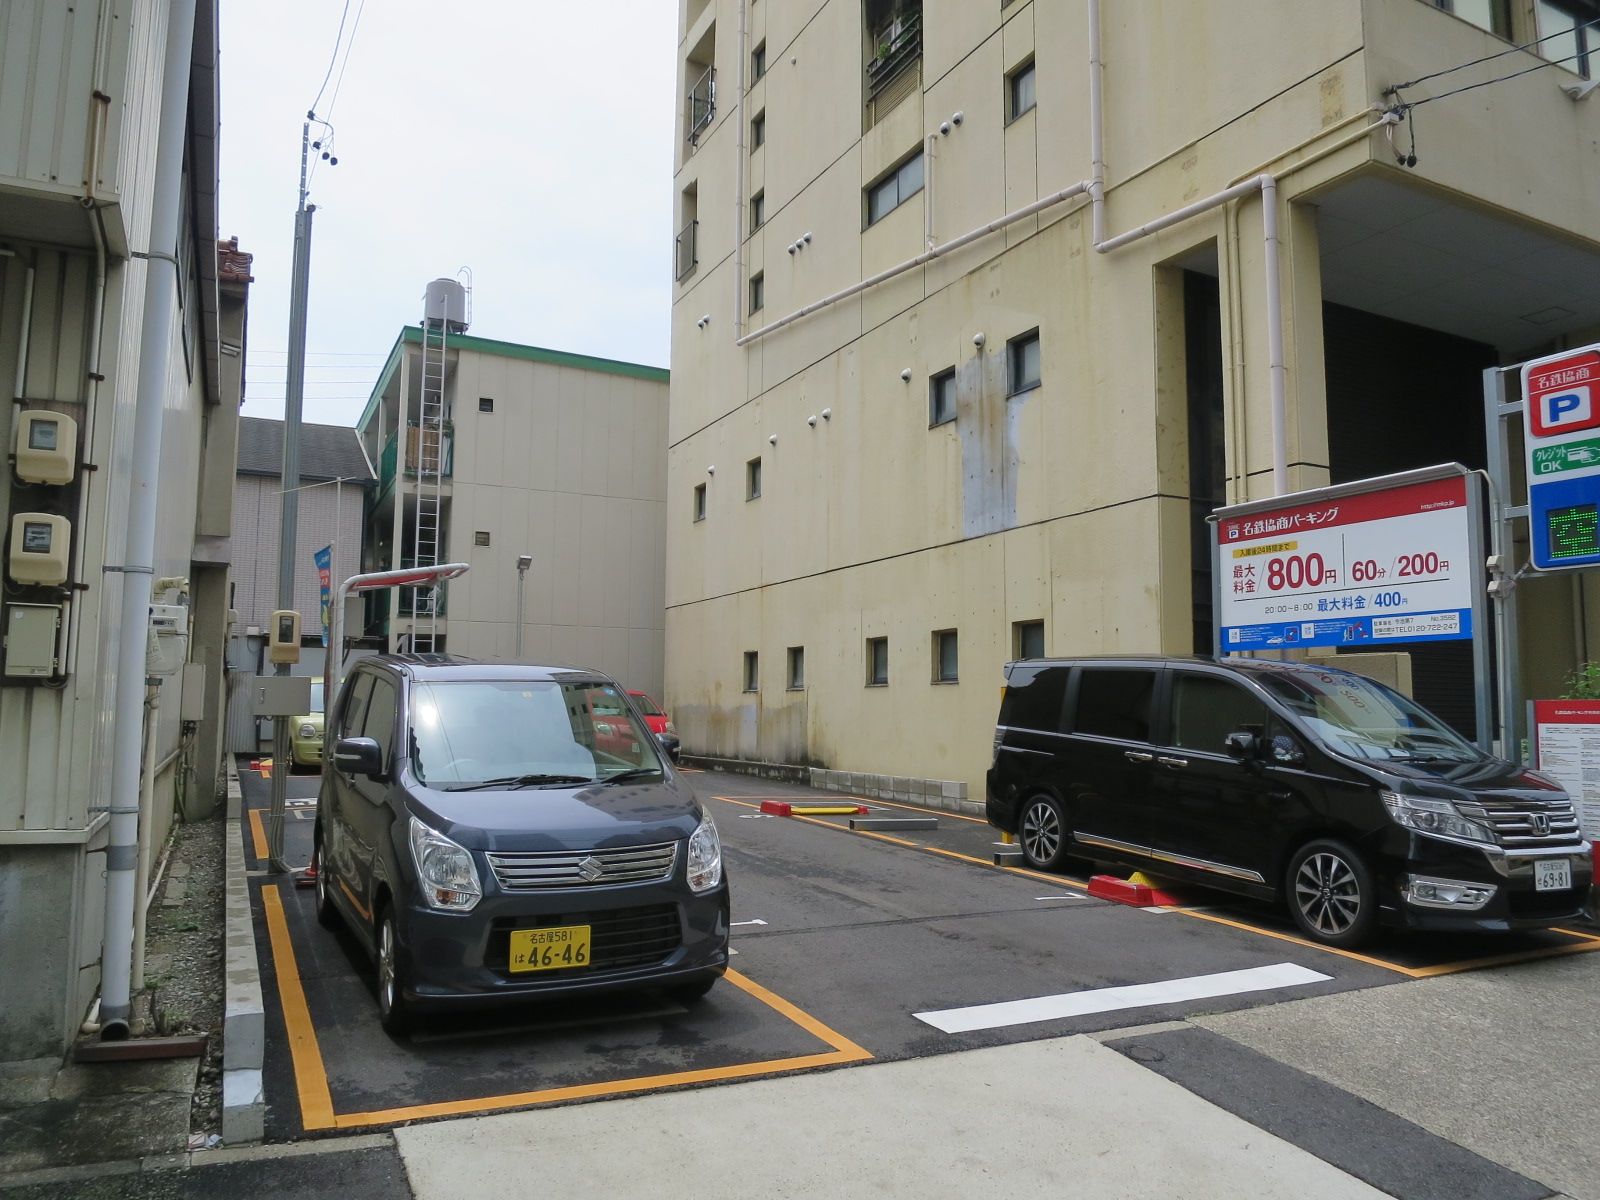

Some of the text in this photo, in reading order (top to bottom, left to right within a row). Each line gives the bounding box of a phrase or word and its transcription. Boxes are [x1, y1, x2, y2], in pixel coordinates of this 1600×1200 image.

[1537, 368, 1590, 389] 名鉄協商
[1548, 394, 1581, 423] P
[1535, 446, 1567, 461] クレジット
[1540, 459, 1562, 473] OK
[1242, 507, 1339, 536] 名鉄協商パーキング
[1549, 508, 1600, 558] 空
[1233, 564, 1256, 579] 最大
[1267, 552, 1337, 591] 800円
[1233, 579, 1256, 594] 料金
[530, 930, 573, 944] 名古屋581
[514, 942, 586, 968] は 46-46
